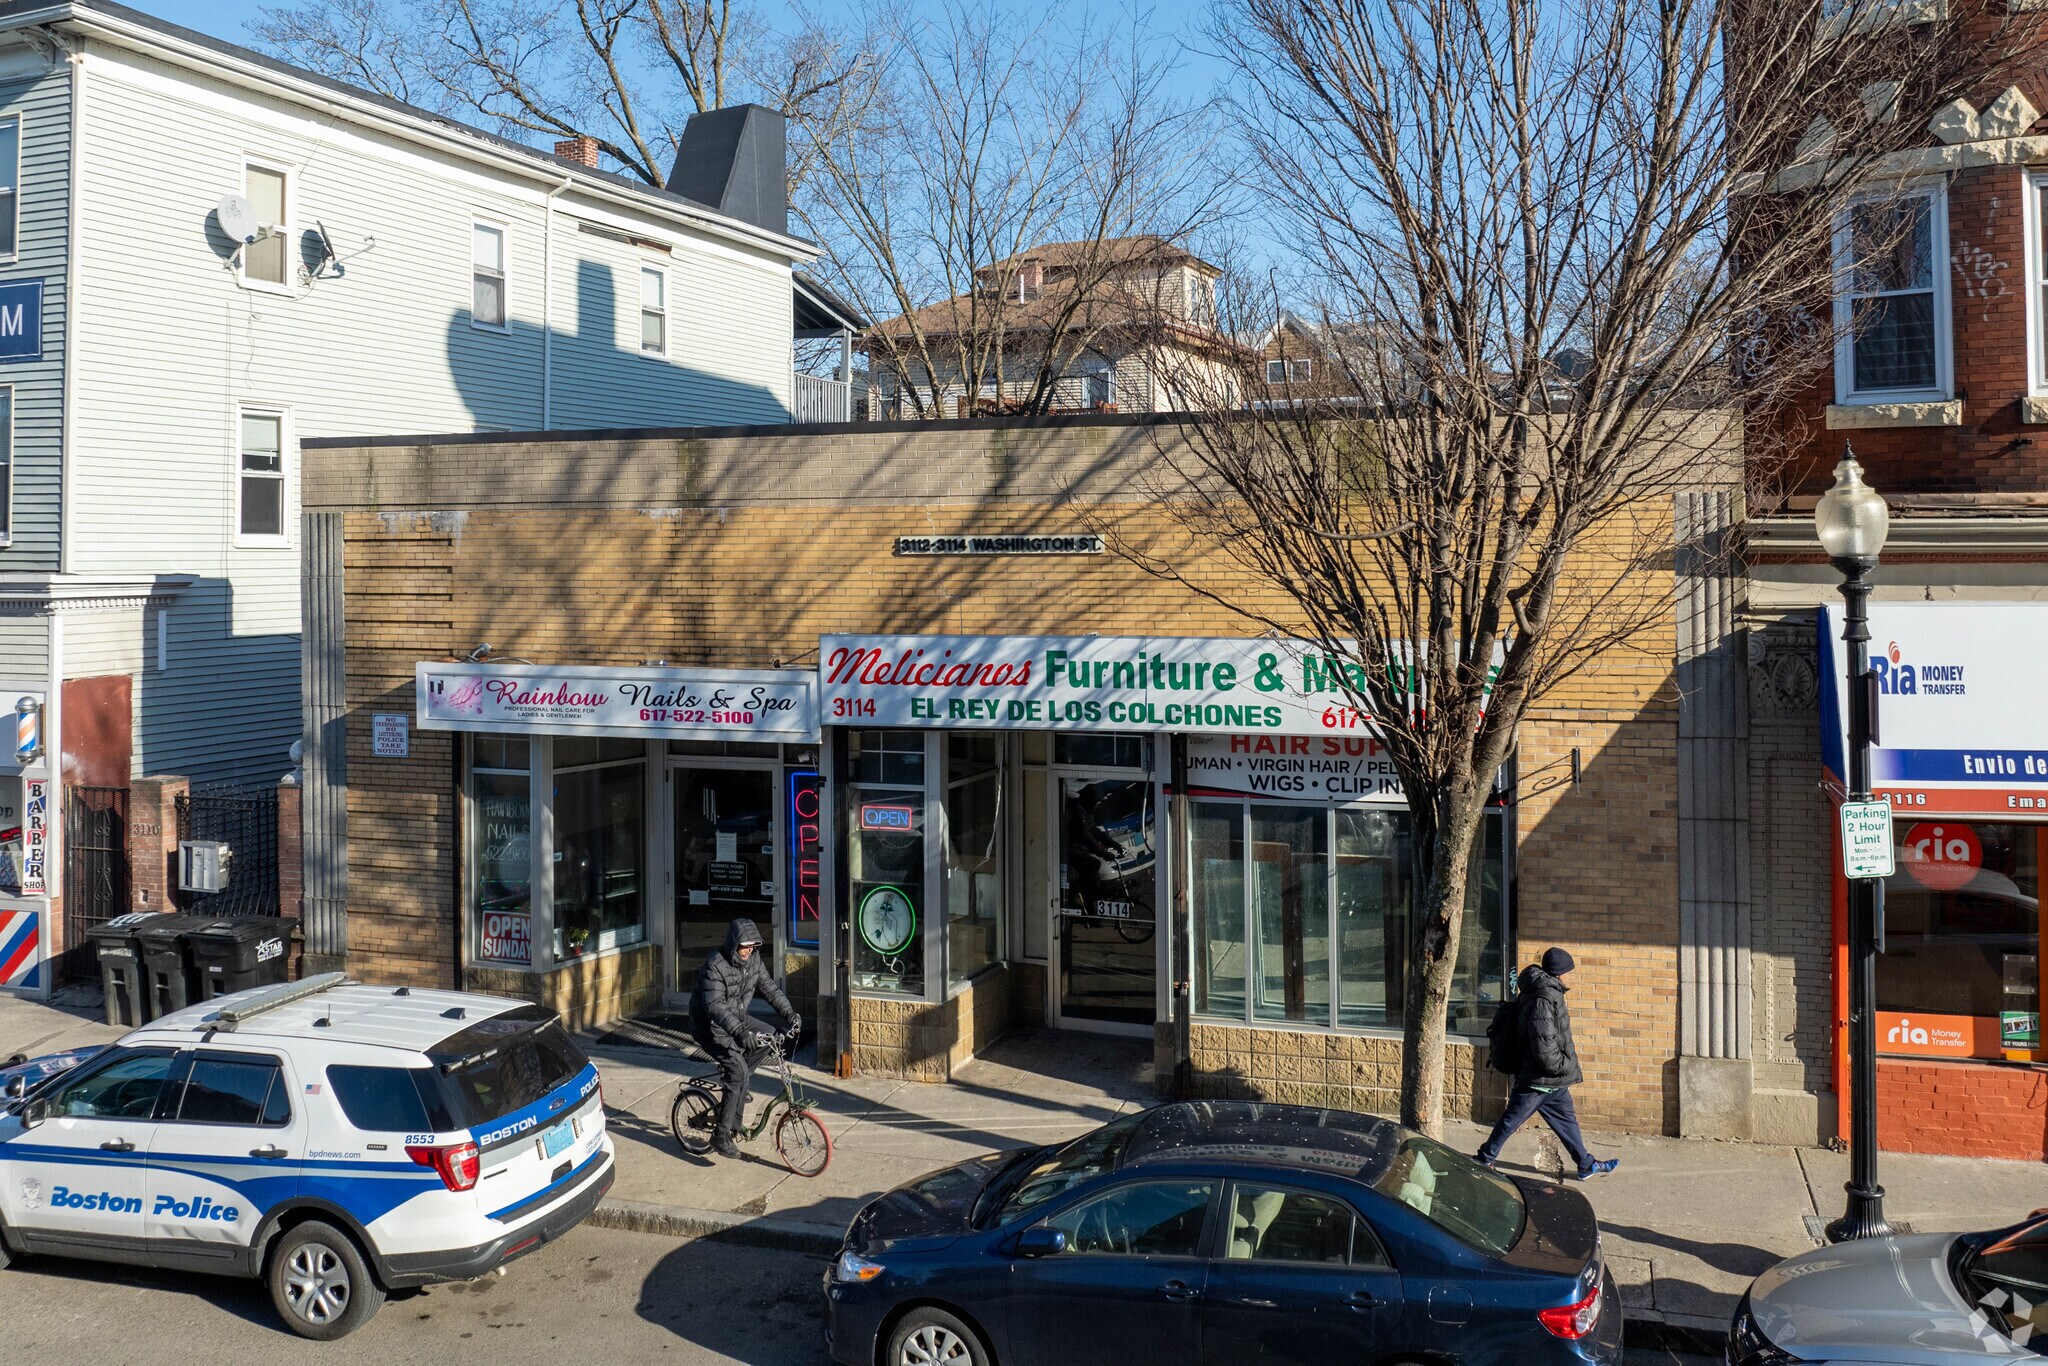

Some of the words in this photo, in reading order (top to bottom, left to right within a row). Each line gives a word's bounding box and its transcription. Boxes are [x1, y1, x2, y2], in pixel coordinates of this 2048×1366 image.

[901, 538, 967, 552] 3112-3114
[972, 538, 1075, 552] WASHINGTON
[826, 647, 1033, 687] Melicianos
[1046, 650, 1237, 691] Furniture
[1253, 652, 1286, 693] &
[1922, 665, 1964, 681] MONEY
[1923, 684, 1966, 695] TRANSFER
[486, 679, 609, 707] Rainbow
[618, 683, 702, 709] Nails
[708, 689, 735, 709] &
[743, 686, 797, 718] Spa
[832, 697, 876, 717] 3114
[911, 697, 942, 719] EL
[948, 698, 1000, 720] REY
[1008, 699, 1042, 722] DE
[1048, 700, 1102, 722] LOS
[1108, 701, 1282, 728] COLCHONES
[639, 709, 754, 725] 617-522-5100
[1231, 735, 1310, 756] HAIR
[1248, 758, 1307, 773] VIRGIN
[1309, 760, 1350, 774] HAIR
[1963, 754, 2017, 775] Envio
[2024, 755, 2048, 775] de
[1248, 774, 1305, 792] WIGS
[1325, 776, 1373, 795] CLIP
[1881, 793, 1927, 805] 3116
[865, 809, 909, 826] OPEN
[1845, 808, 1887, 820] Parking
[28, 783, 43, 879] BARBER
[133, 823, 160, 836] 3110
[1848, 822, 1855, 832] 2
[1859, 822, 1886, 831] Hour
[1854, 834, 1881, 845] Limit
[1914, 827, 1970, 862] ria
[795, 789, 819, 921] OPEN
[24, 881, 46, 889] SHOP
[1098, 901, 1129, 917] 3114
[488, 915, 531, 939] OPEN
[484, 939, 531, 959] SUNDAY
[1888, 1018, 1928, 1045] ria
[1931, 1028, 1962, 1040] Money
[1931, 1038, 1967, 1048] Transfer
[480, 1114, 538, 1147] BOSTON
[404, 1134, 435, 1145] 8553
[308, 1149, 361, 1160] bpdnews.com
[50, 1185, 143, 1214] Boston
[152, 1194, 240, 1223] Police
